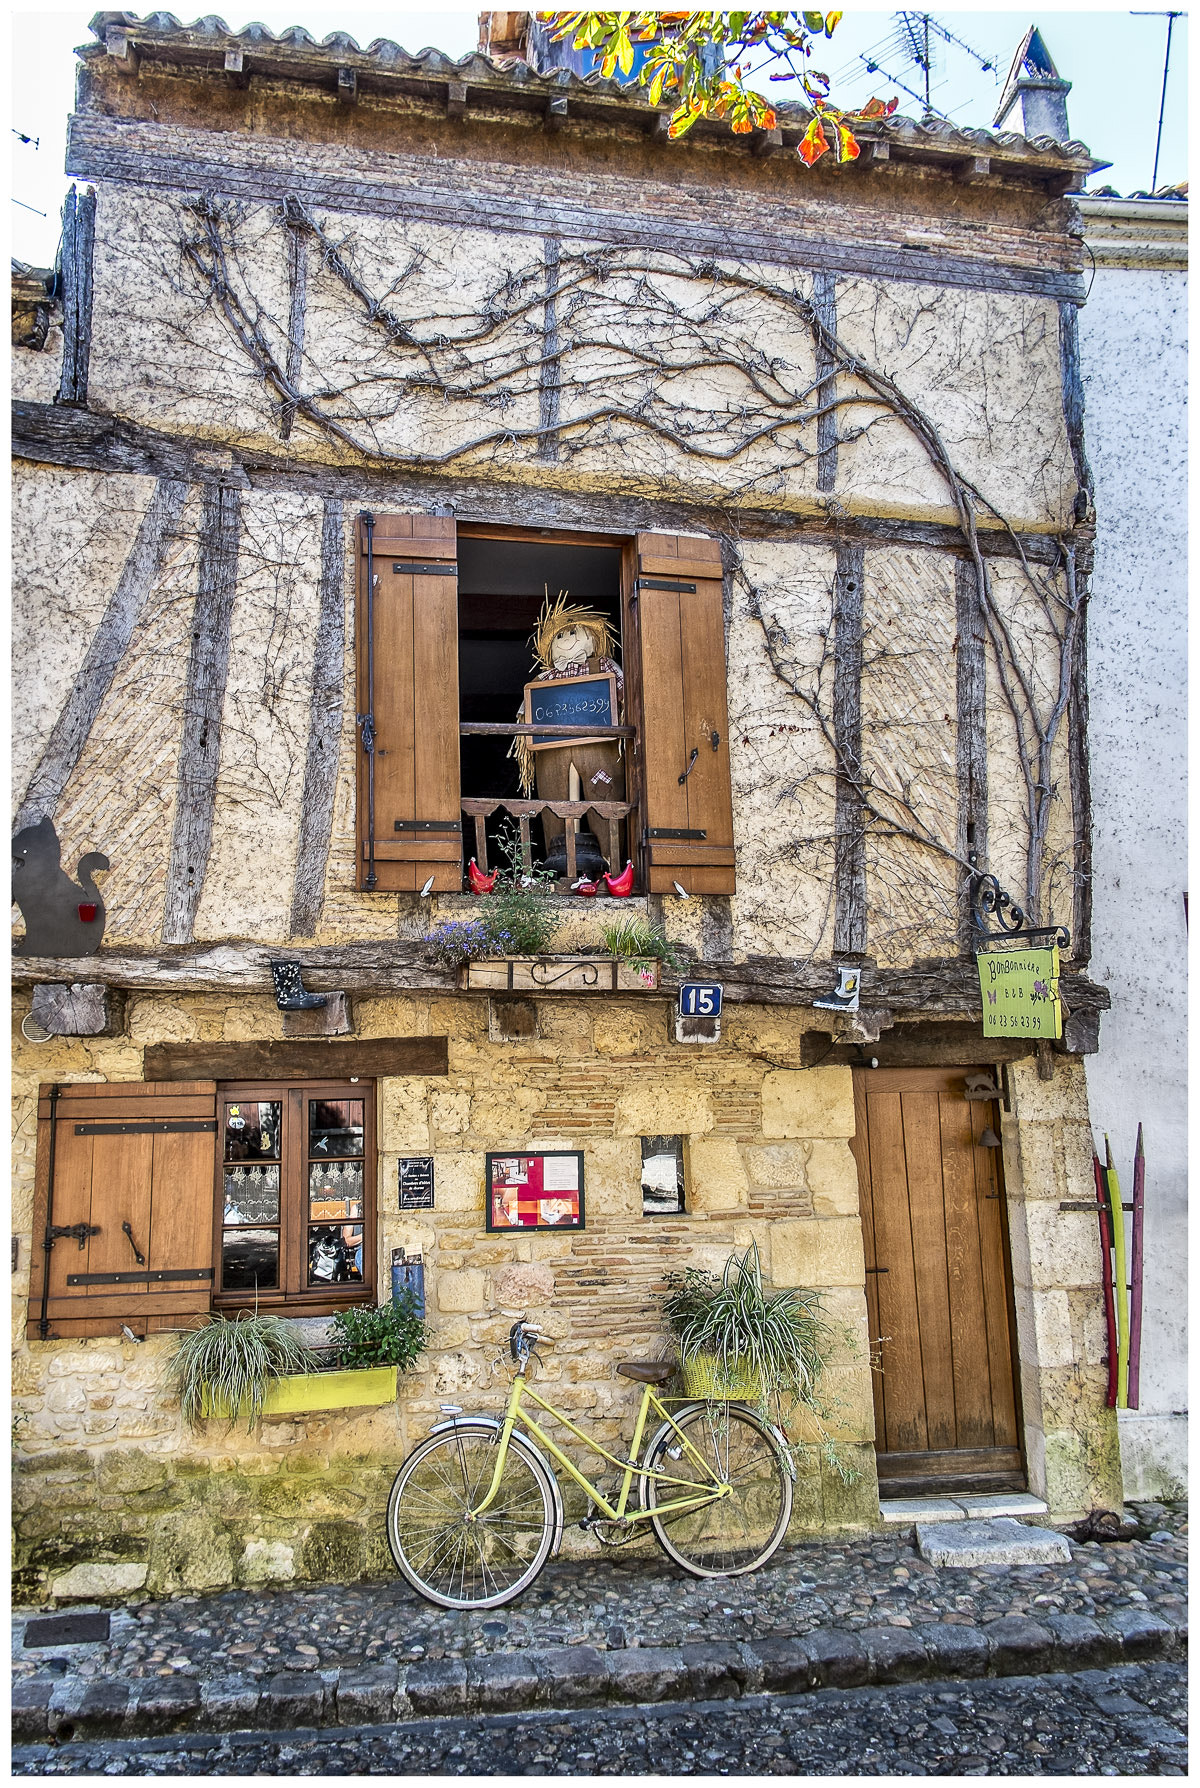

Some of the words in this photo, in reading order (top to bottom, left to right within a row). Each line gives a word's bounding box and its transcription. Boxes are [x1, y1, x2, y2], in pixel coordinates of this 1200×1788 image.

[688, 988, 714, 1014] 15
[988, 1014, 997, 1026] 06
[999, 1015, 1008, 1027] 23
[1010, 1015, 1018, 1028] 56
[1020, 1015, 1030, 1029] 23
[1032, 1016, 1041, 1030] 99
